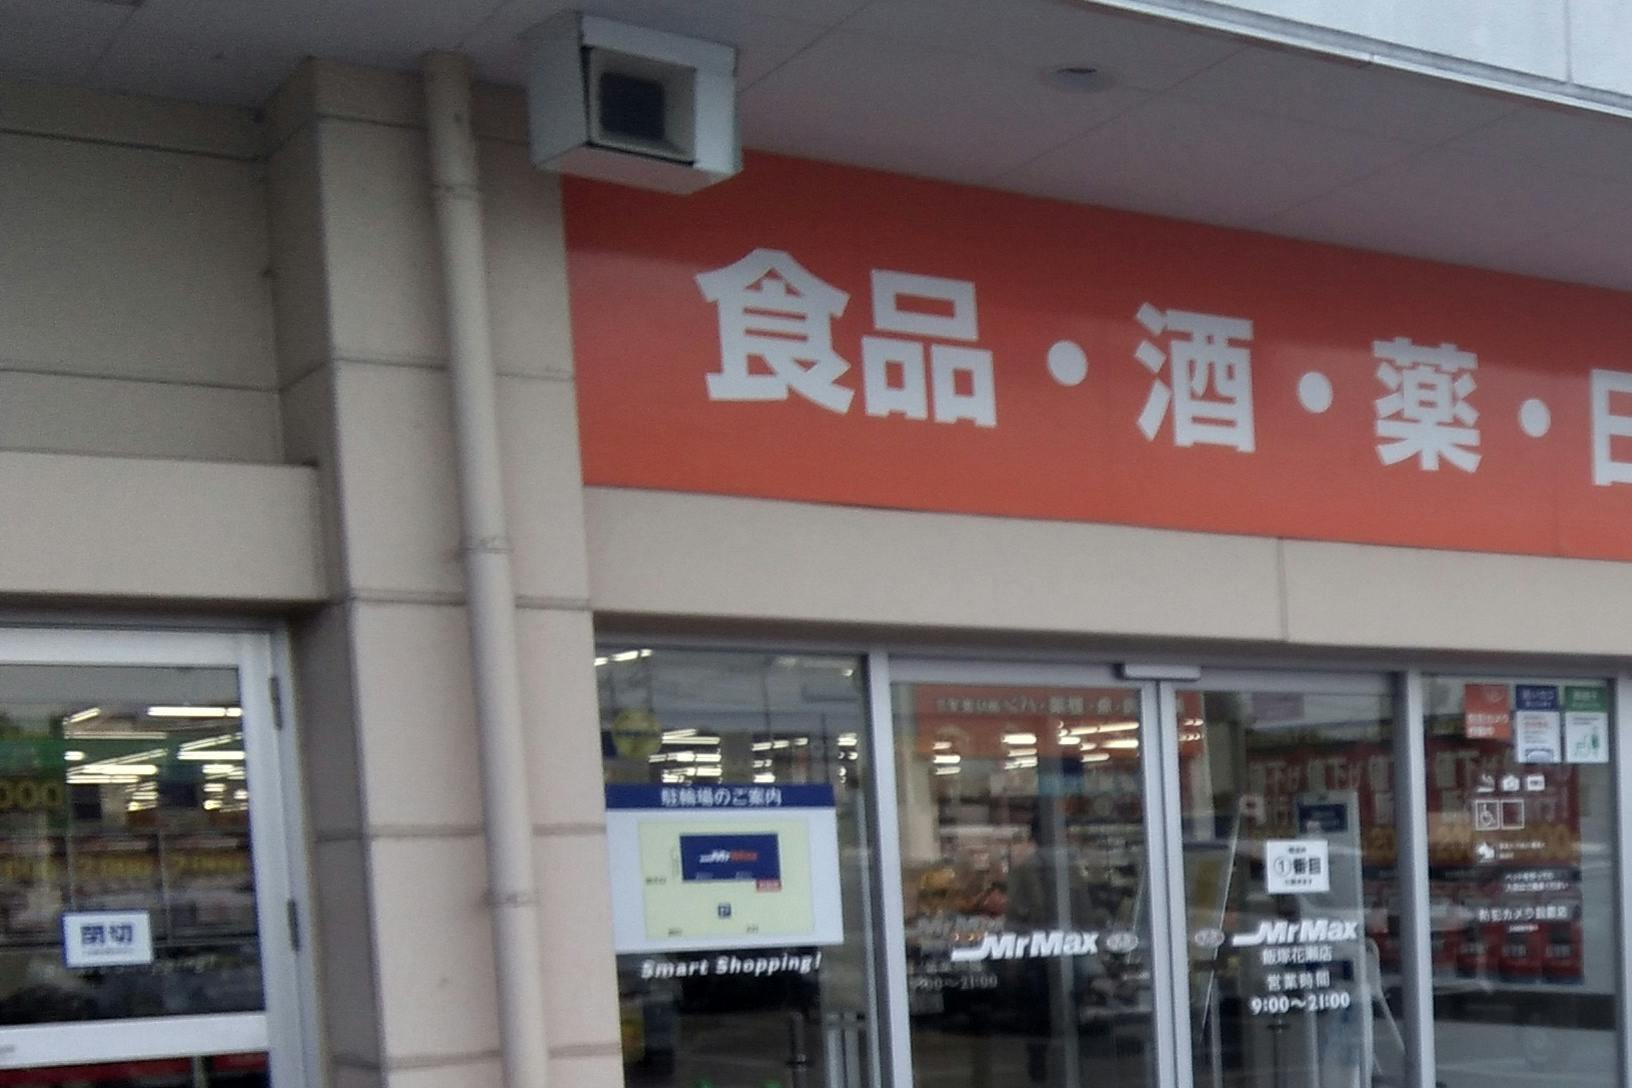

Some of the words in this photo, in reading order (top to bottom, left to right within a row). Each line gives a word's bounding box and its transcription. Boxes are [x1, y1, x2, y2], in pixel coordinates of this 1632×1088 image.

[660, 786, 783, 807] 駐輪場のご案内
[951, 930, 1099, 961] MrMax
[1232, 919, 1358, 946] MrMax
[640, 959, 709, 981] Smart
[715, 951, 822, 977] Shopping!
